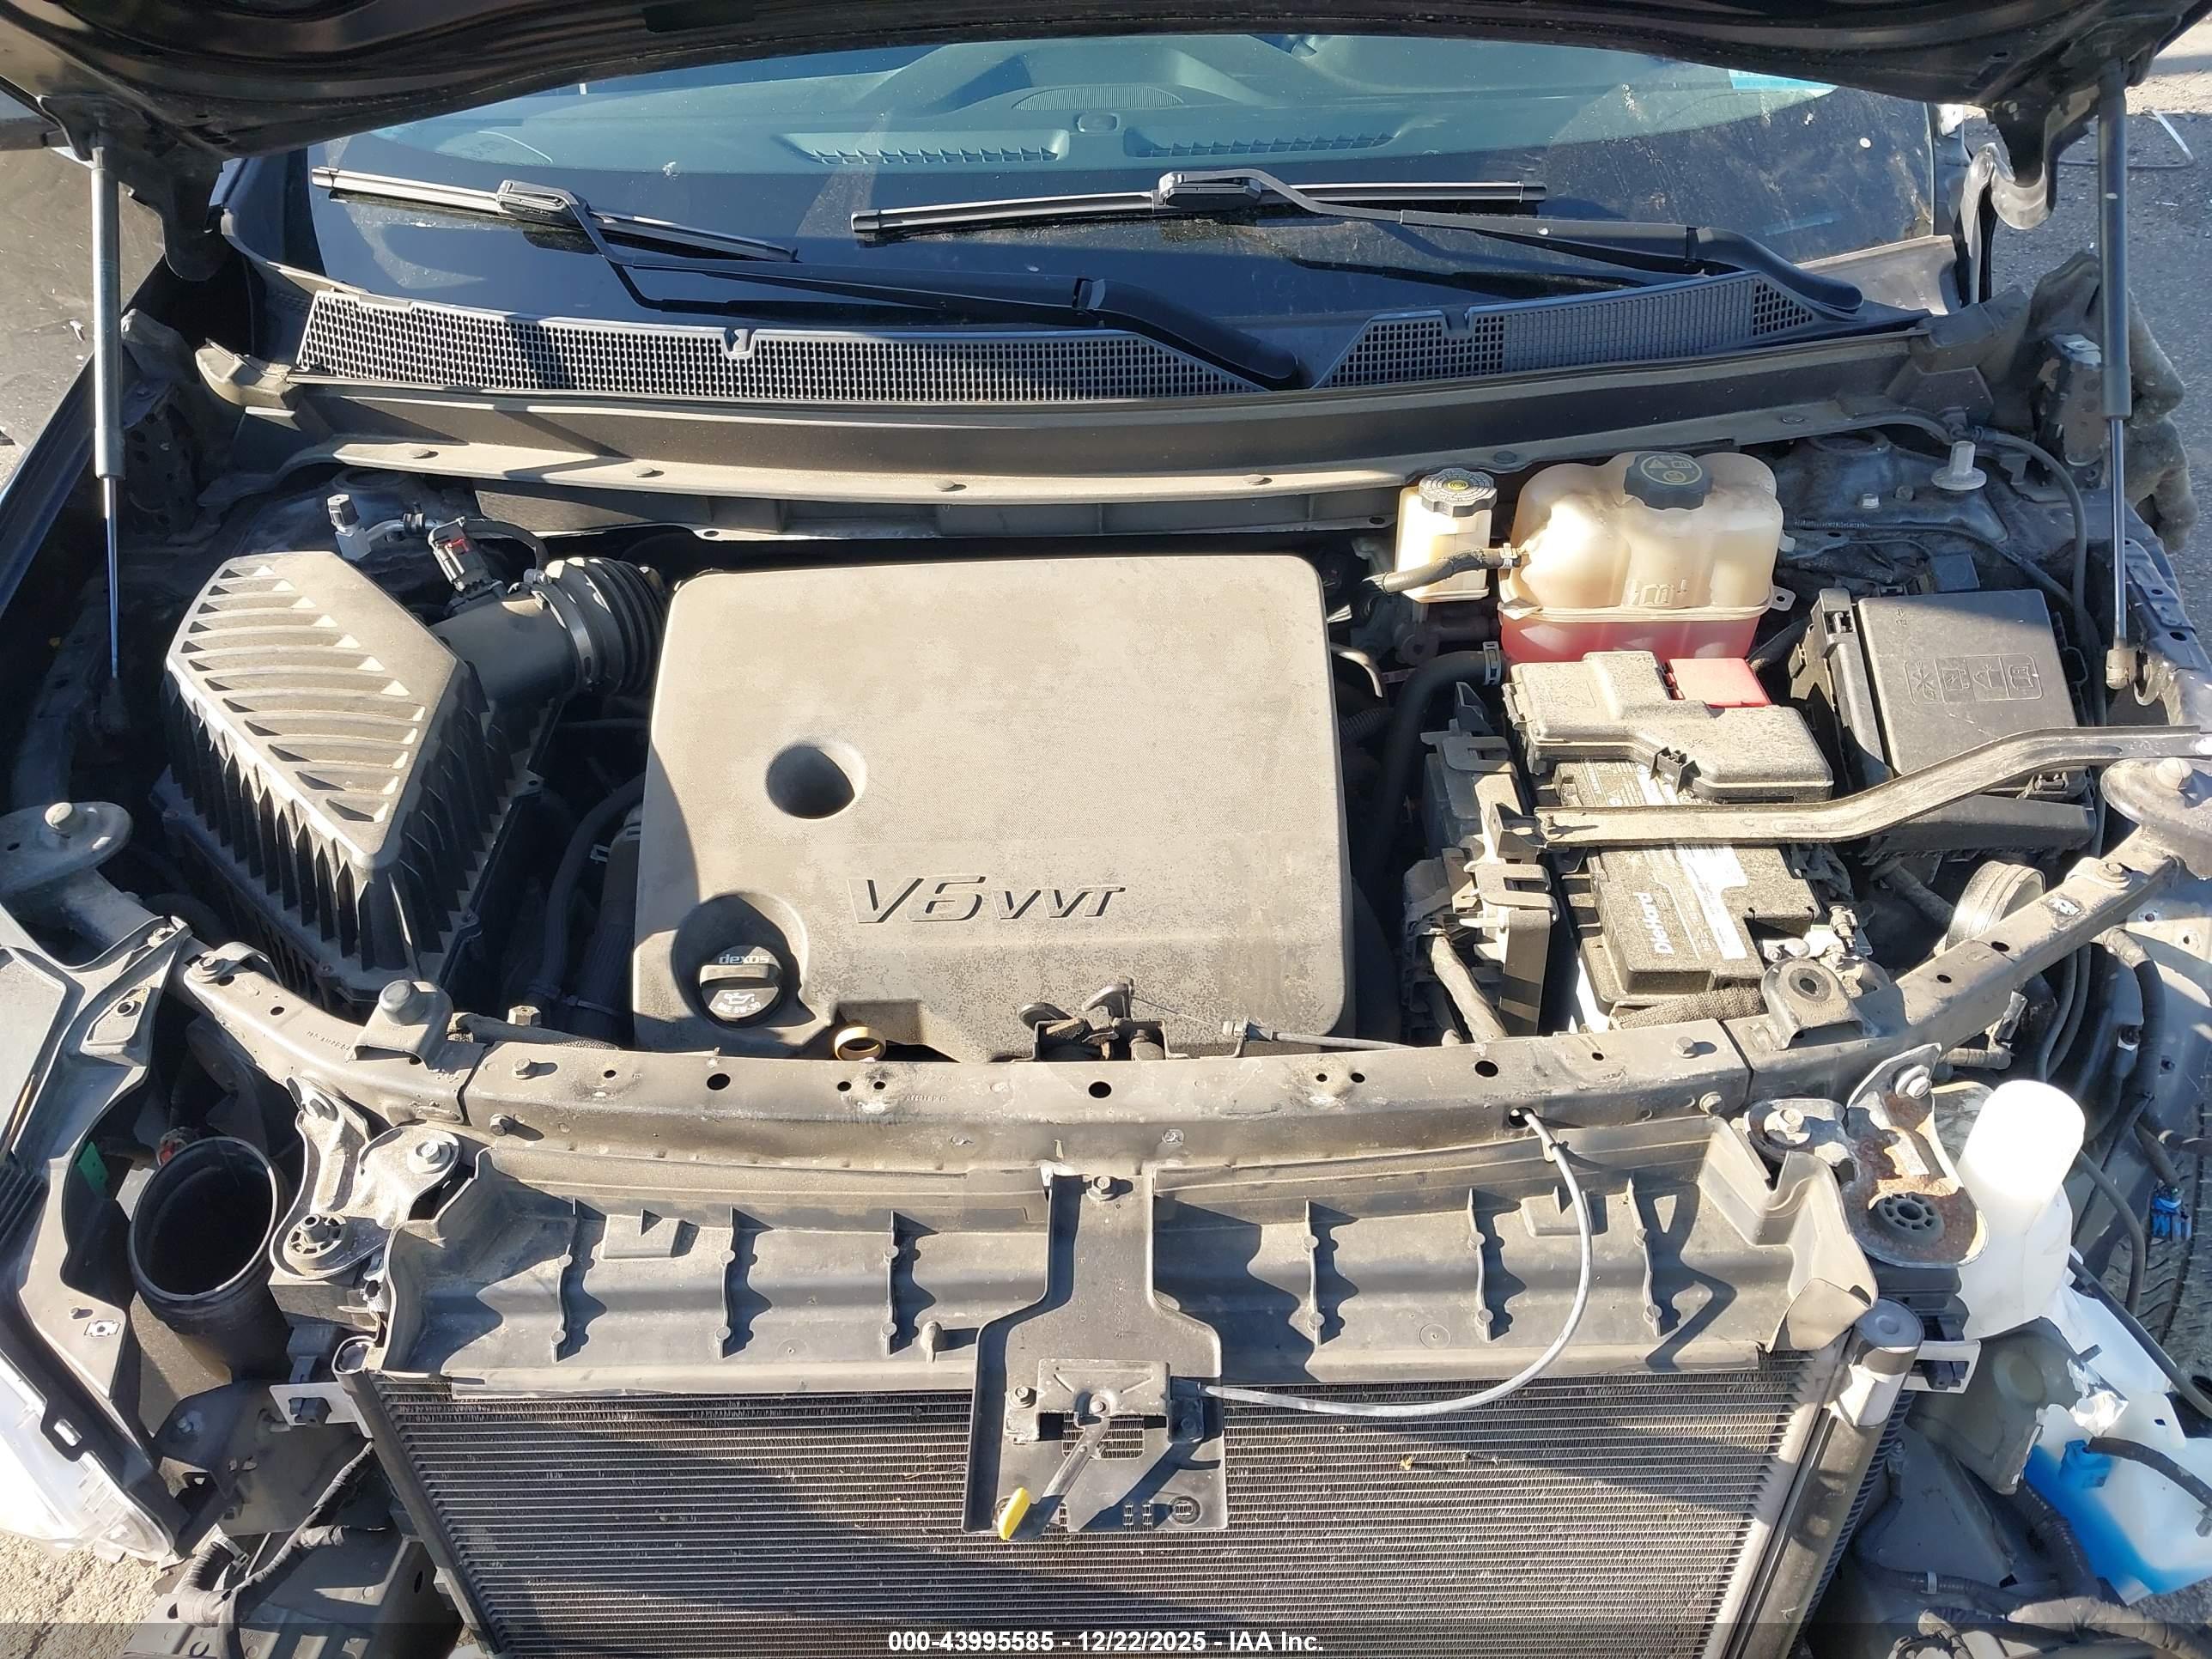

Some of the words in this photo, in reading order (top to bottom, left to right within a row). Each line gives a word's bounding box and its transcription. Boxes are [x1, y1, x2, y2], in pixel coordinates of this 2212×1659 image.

[847, 873, 987, 924] V6
[993, 886, 1127, 921] VVT
[1632, 891, 1674, 955] DieHard
[719, 953, 770, 964] dexos
[734, 1001, 761, 1013] 5W-30
